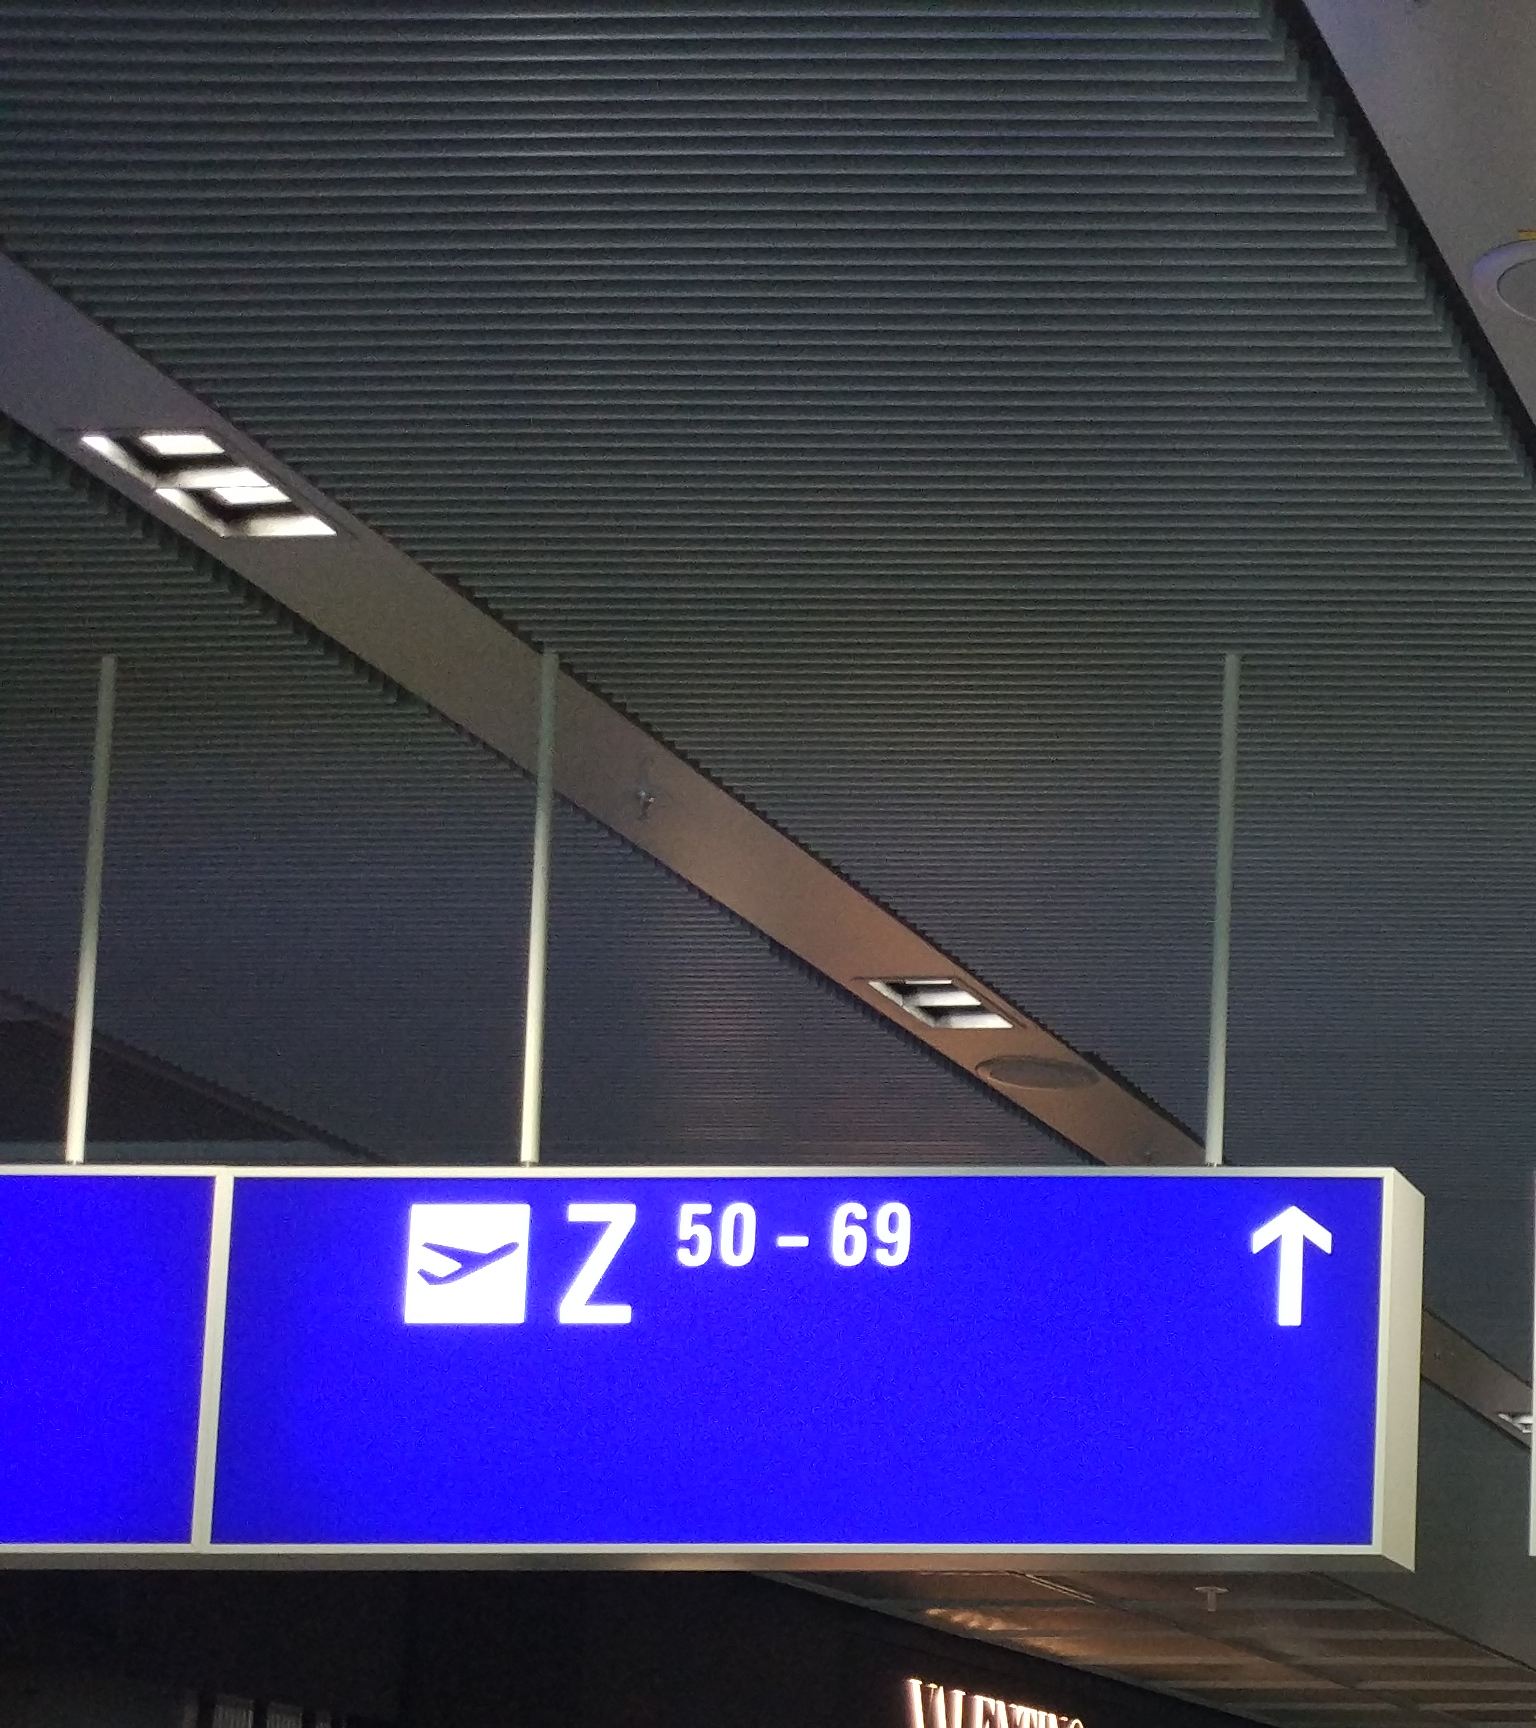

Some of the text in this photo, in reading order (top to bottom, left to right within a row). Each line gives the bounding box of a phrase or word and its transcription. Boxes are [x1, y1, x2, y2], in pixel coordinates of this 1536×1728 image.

[558, 1202, 637, 1324] Z
[676, 1202, 756, 1267] 50
[831, 1202, 912, 1267] 69
